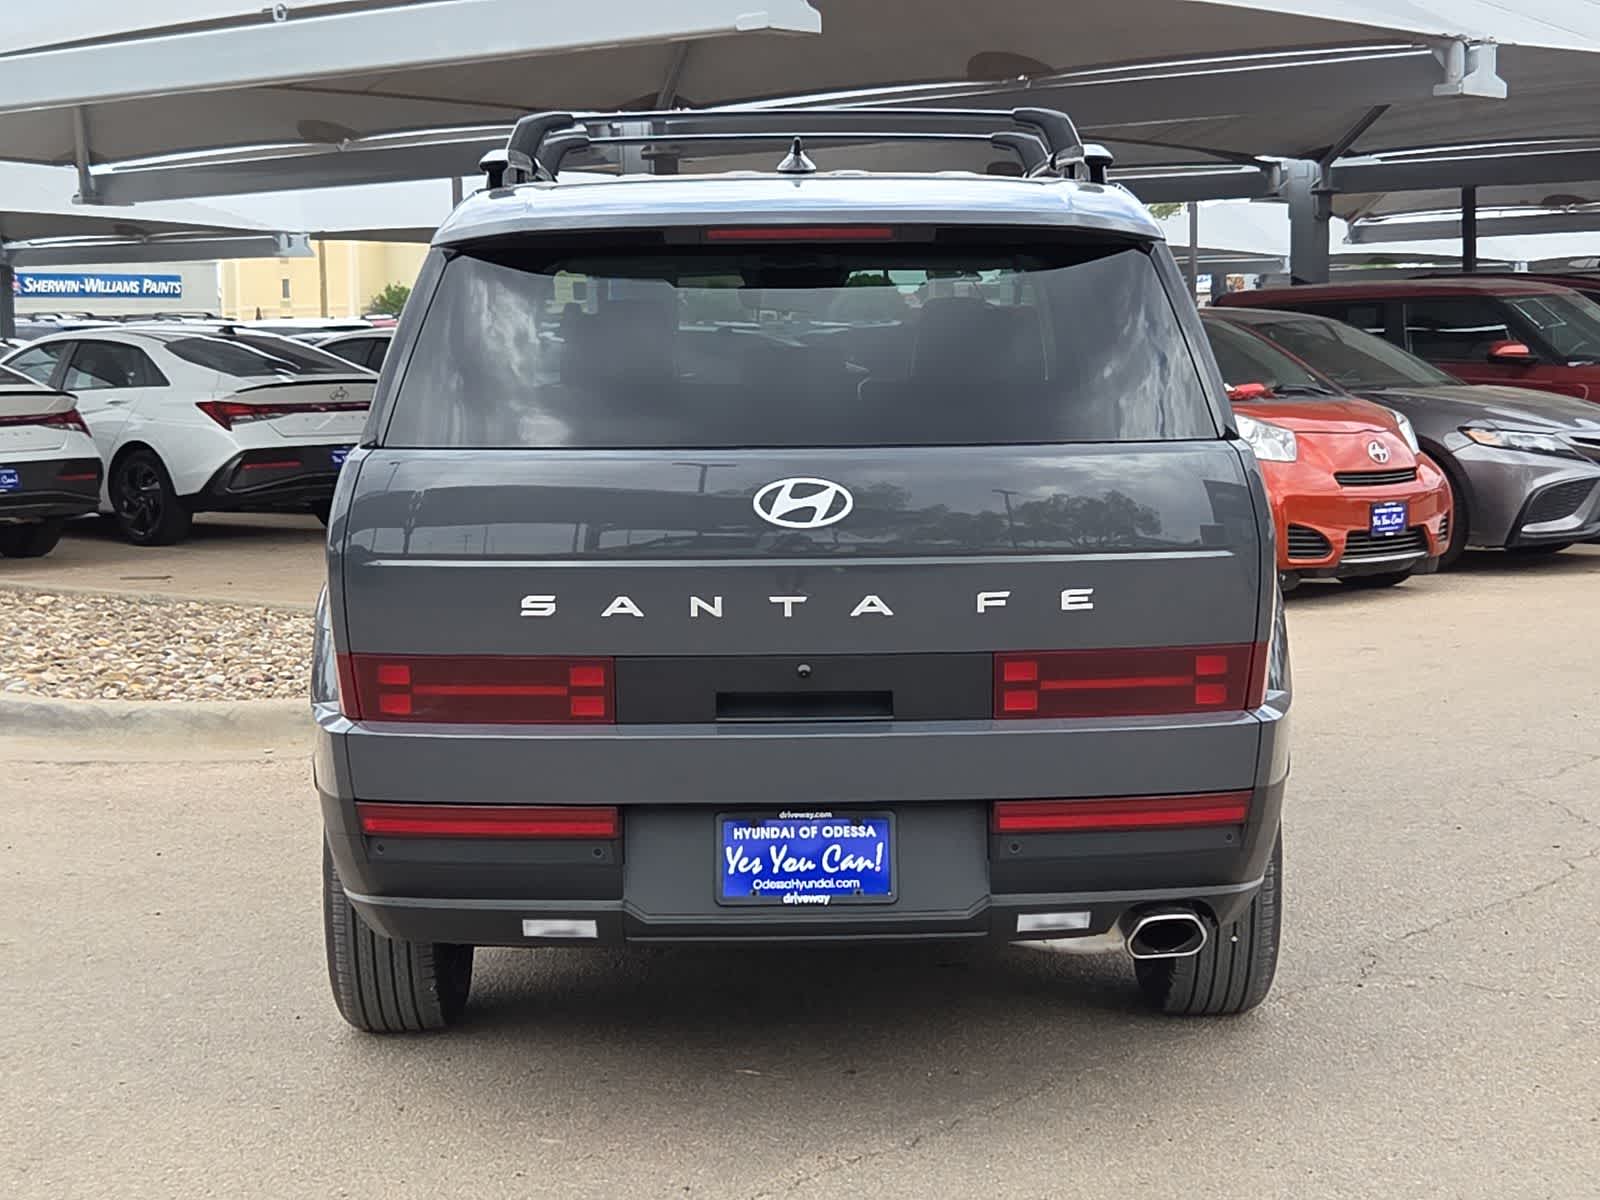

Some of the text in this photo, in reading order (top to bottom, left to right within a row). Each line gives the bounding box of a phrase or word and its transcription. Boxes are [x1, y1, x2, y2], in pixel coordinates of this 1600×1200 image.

[23, 277, 182, 294] SHERWIN-WILLIAMS PAINTS
[520, 588, 1094, 618] SANTA FE
[779, 811, 833, 820] driveway.com
[733, 825, 876, 840] HYUNDAI OF ODESSA
[725, 842, 884, 874] Yes You Can!
[753, 878, 860, 891] OdessaHyundai.com
[783, 892, 831, 905] driveway
